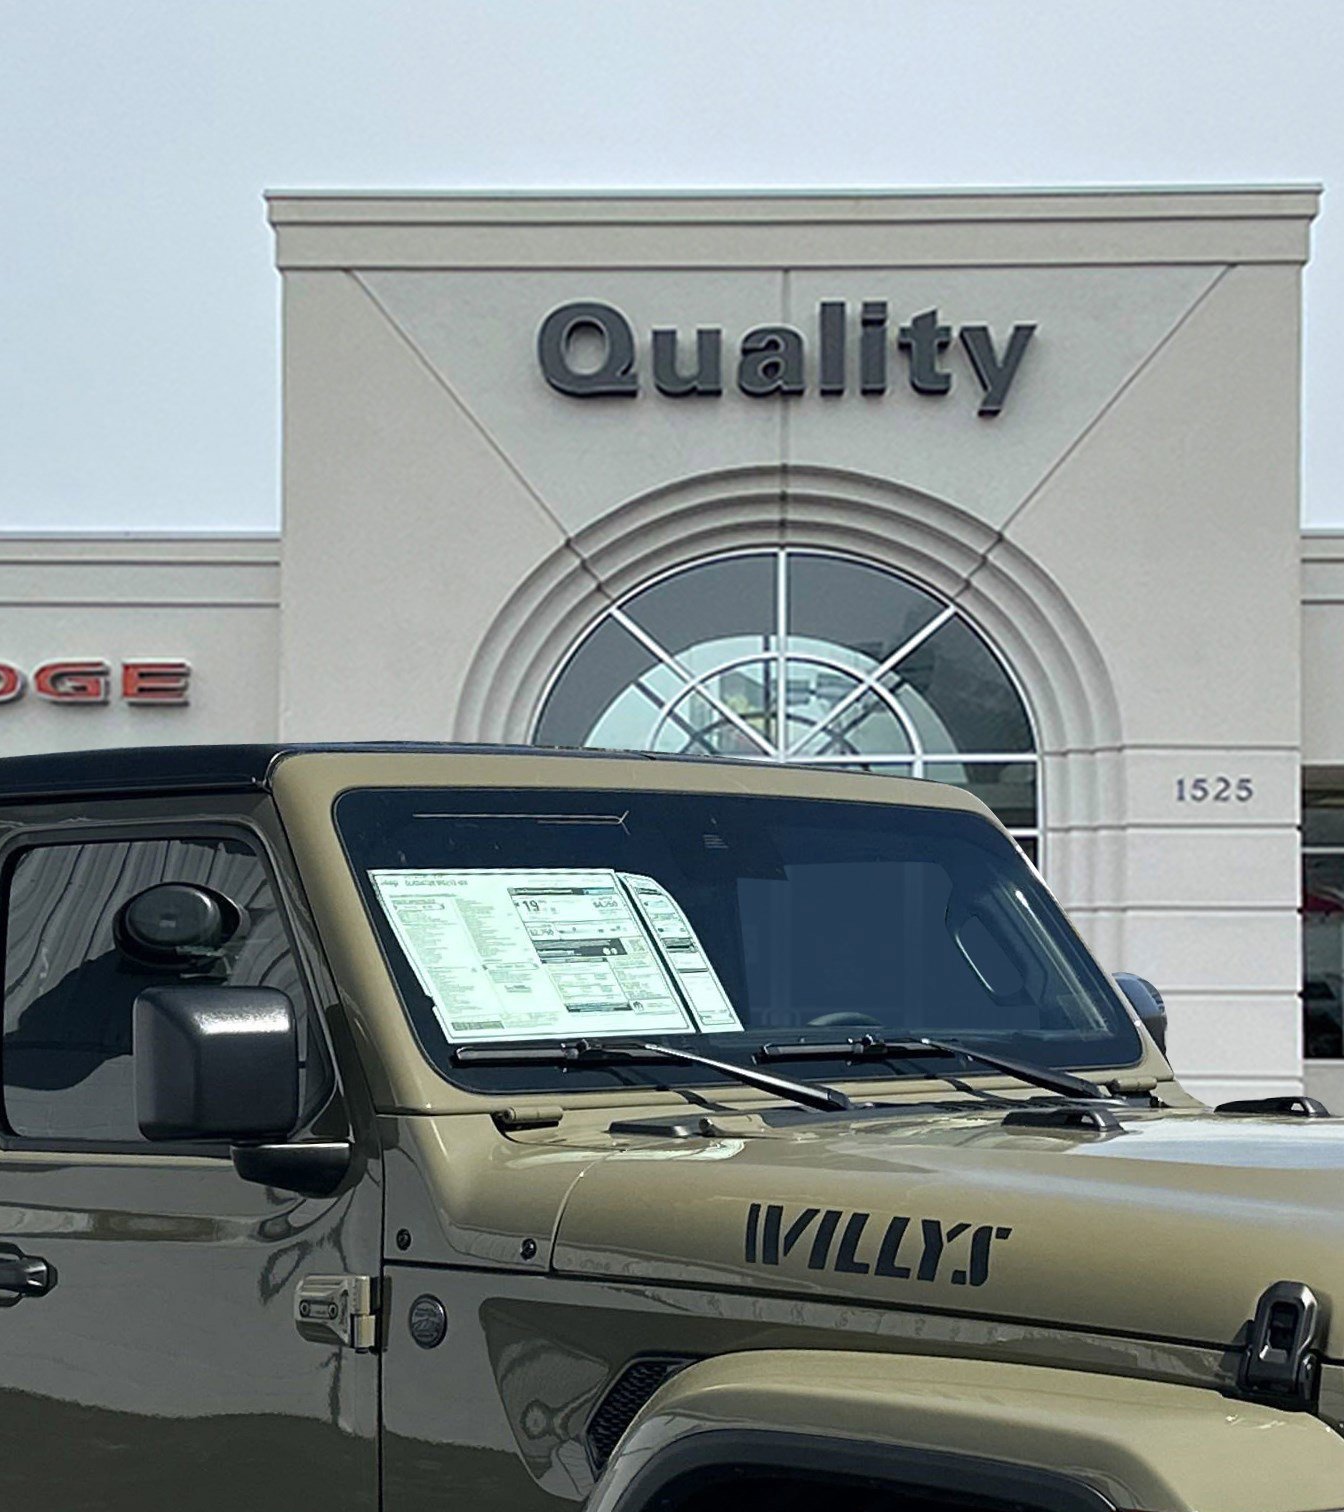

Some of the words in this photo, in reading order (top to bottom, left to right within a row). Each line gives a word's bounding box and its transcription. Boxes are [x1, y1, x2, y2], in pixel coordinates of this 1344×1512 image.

[536, 298, 1038, 417] Quality
[1174, 776, 1254, 803] 1525
[744, 1203, 1013, 1287] WILLYS
